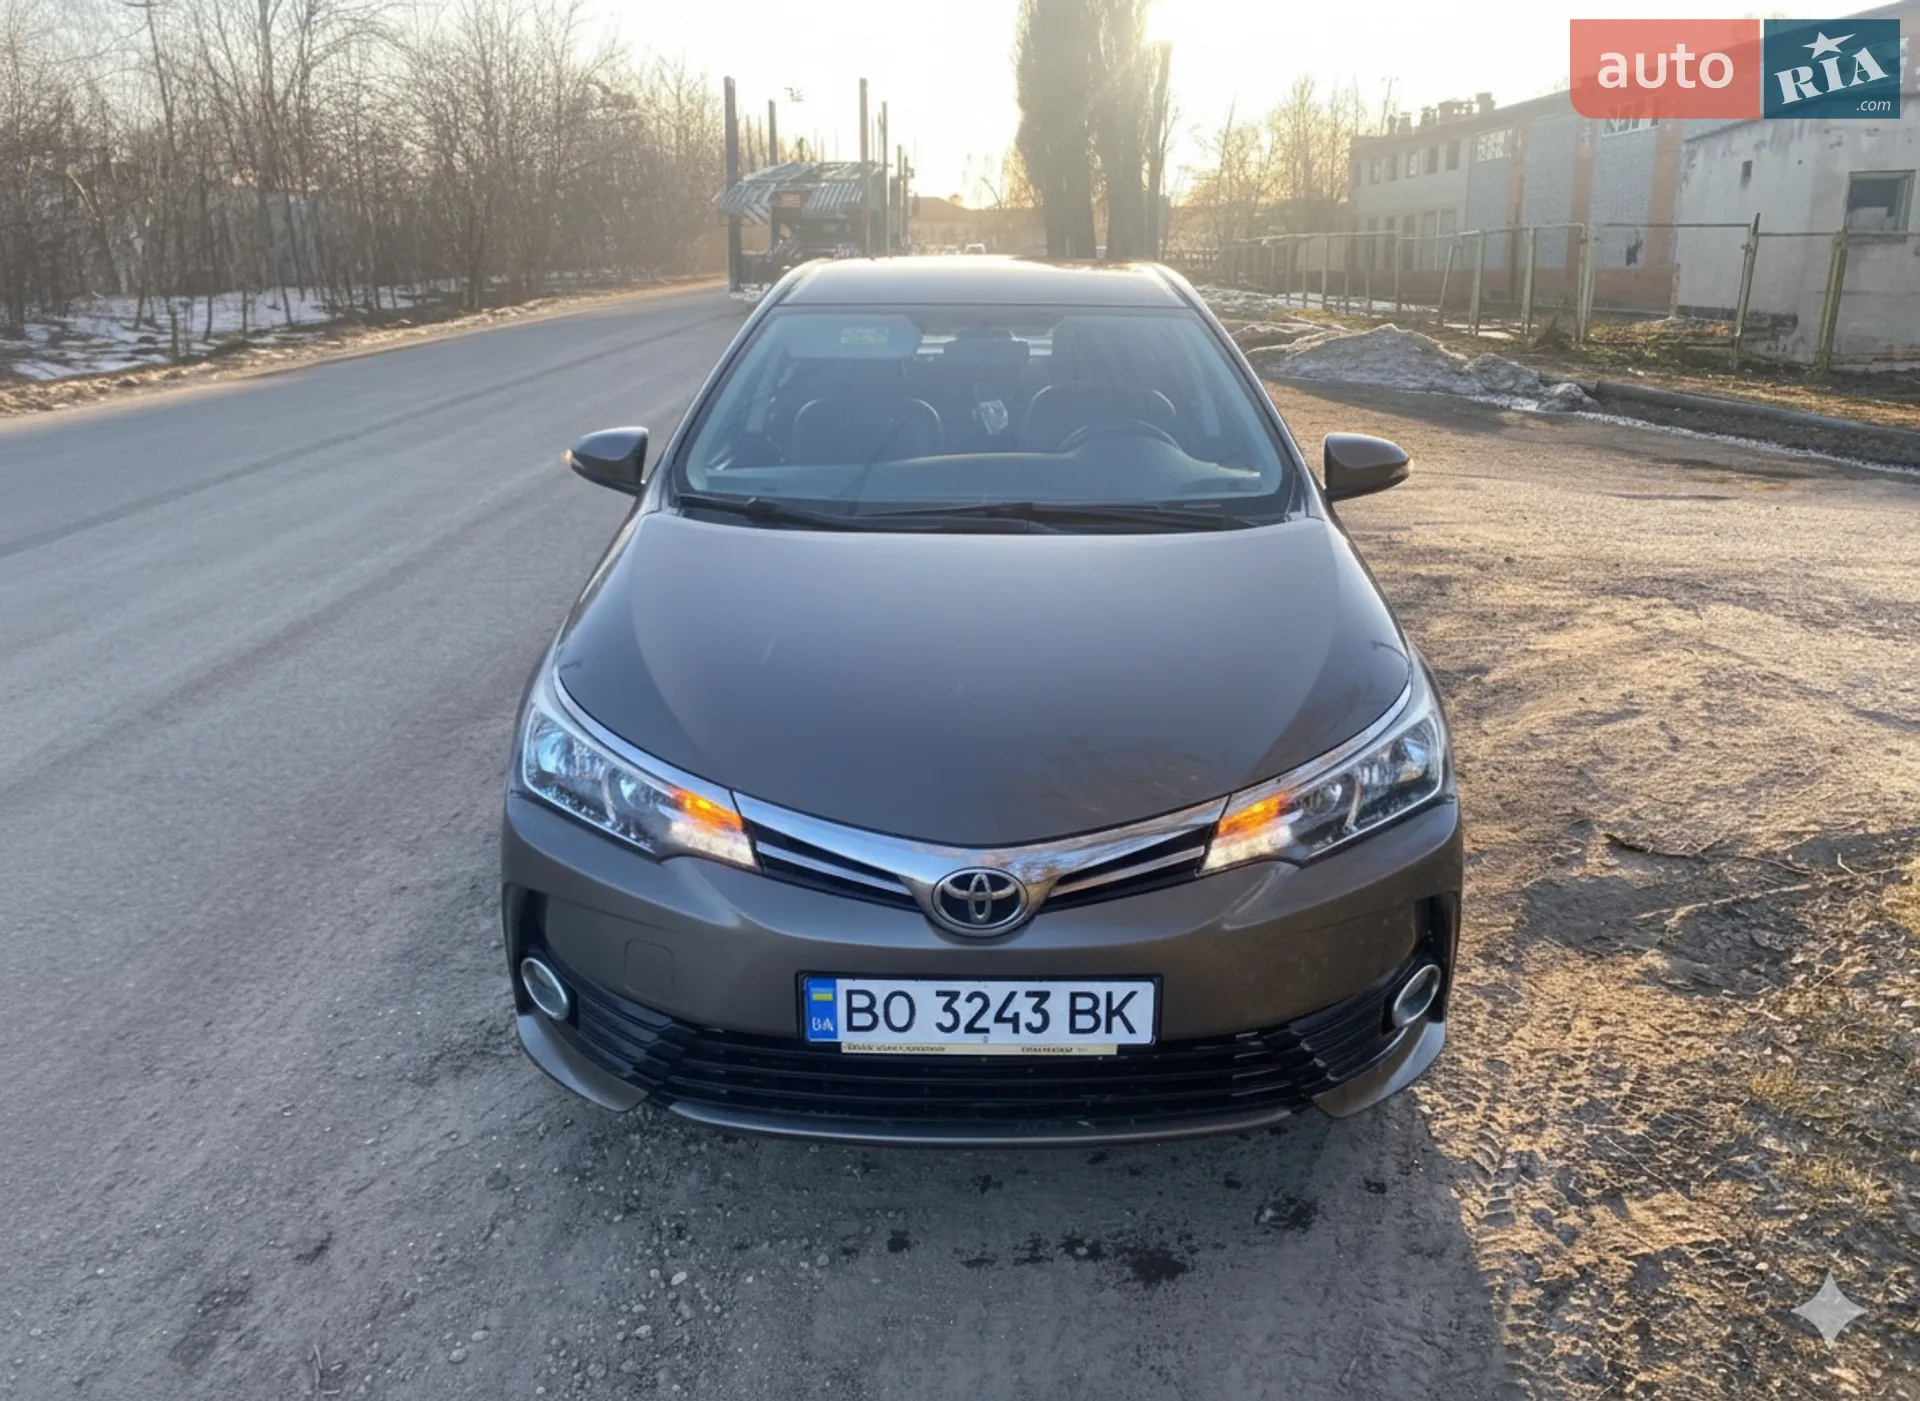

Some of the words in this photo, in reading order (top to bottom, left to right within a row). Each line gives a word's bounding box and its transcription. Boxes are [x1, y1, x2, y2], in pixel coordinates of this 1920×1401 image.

[846, 989, 915, 1033] BO
[935, 990, 1051, 1035] 3243
[1068, 990, 1138, 1035] BK
